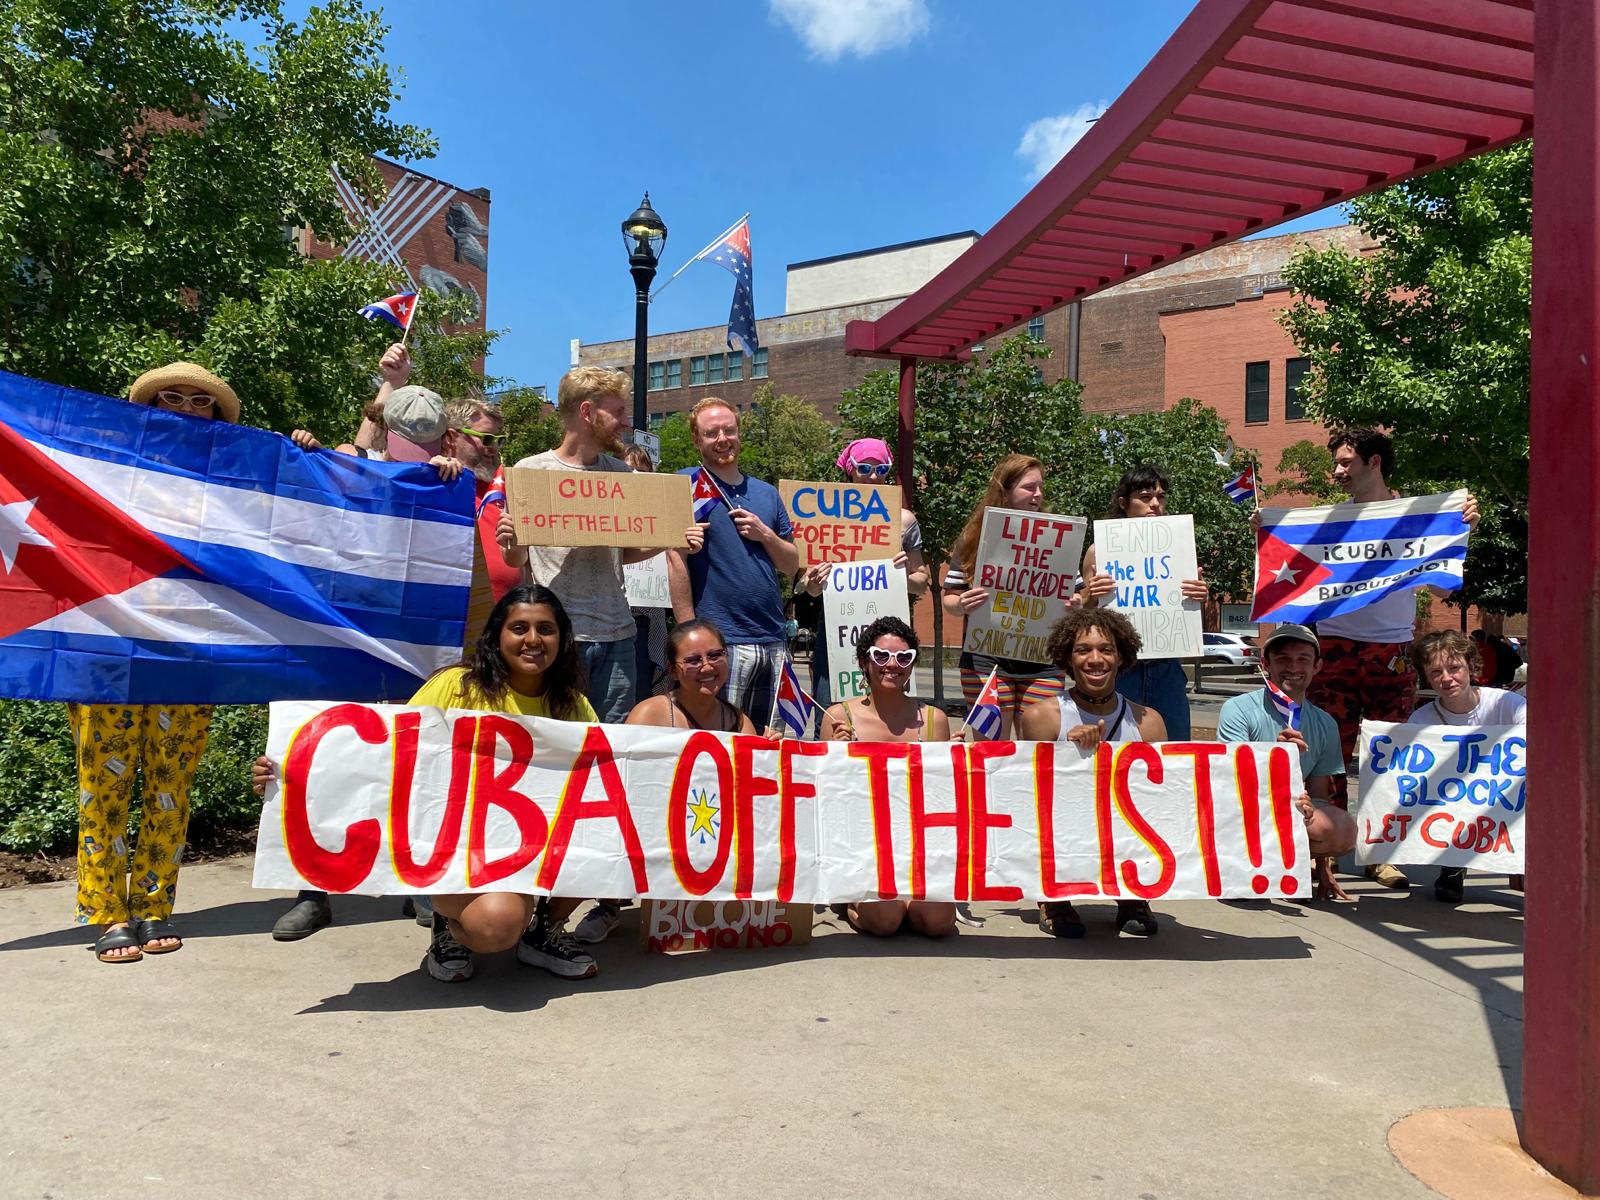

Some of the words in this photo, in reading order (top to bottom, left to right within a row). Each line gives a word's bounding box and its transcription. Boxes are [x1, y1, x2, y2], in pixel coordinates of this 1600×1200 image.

[558, 477, 625, 500] CUBA
[792, 487, 891, 523] CUBA
[521, 513, 657, 535] #OFFTHELIST
[849, 525, 891, 546] THE
[1002, 516, 1073, 548] LIFT
[1105, 520, 1173, 553] END
[807, 543, 863, 565] LIST
[1011, 544, 1053, 570] THE
[1105, 560, 1135, 581] the
[1144, 555, 1174, 580] U.S.
[833, 564, 889, 592] CUBA
[980, 564, 1074, 600] BLOCKADE
[840, 602, 855, 616] IS
[865, 601, 878, 615] A
[992, 591, 1046, 620] END
[1116, 584, 1162, 608] WAR
[1128, 609, 1192, 653] UBA
[1370, 734, 1436, 774] END
[1442, 733, 1526, 777] THE
[282, 703, 649, 894] CUBA
[667, 731, 828, 902] OFF
[1365, 814, 1412, 844] LET
[1420, 812, 1516, 854] CUBA
[649, 935, 684, 952] NO
[693, 927, 739, 950] NO
[747, 922, 792, 949] NO
